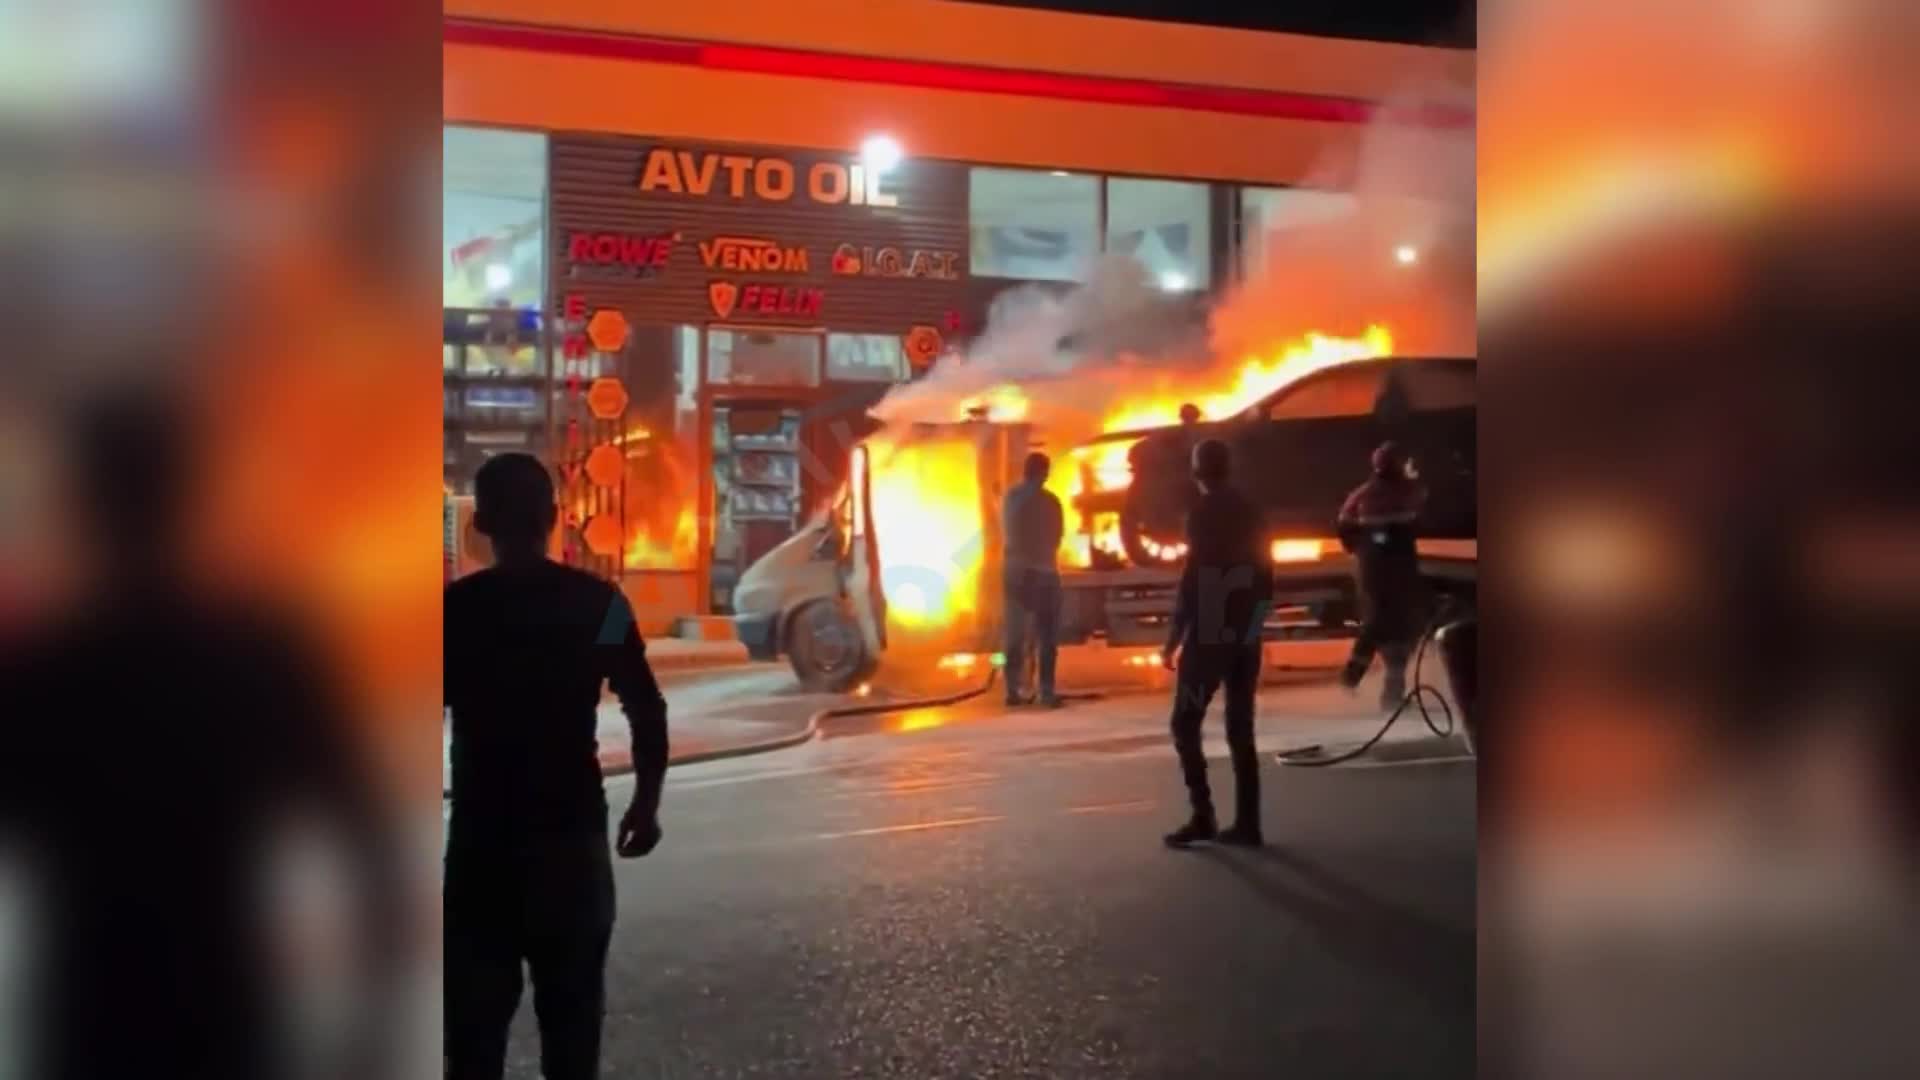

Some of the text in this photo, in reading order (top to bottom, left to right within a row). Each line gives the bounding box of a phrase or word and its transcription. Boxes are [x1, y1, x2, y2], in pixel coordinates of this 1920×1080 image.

[640, 149, 898, 207] AVTO OIL
[570, 232, 672, 267] ROWE
[699, 236, 809, 272] VENOM
[741, 286, 824, 316] FELIX
